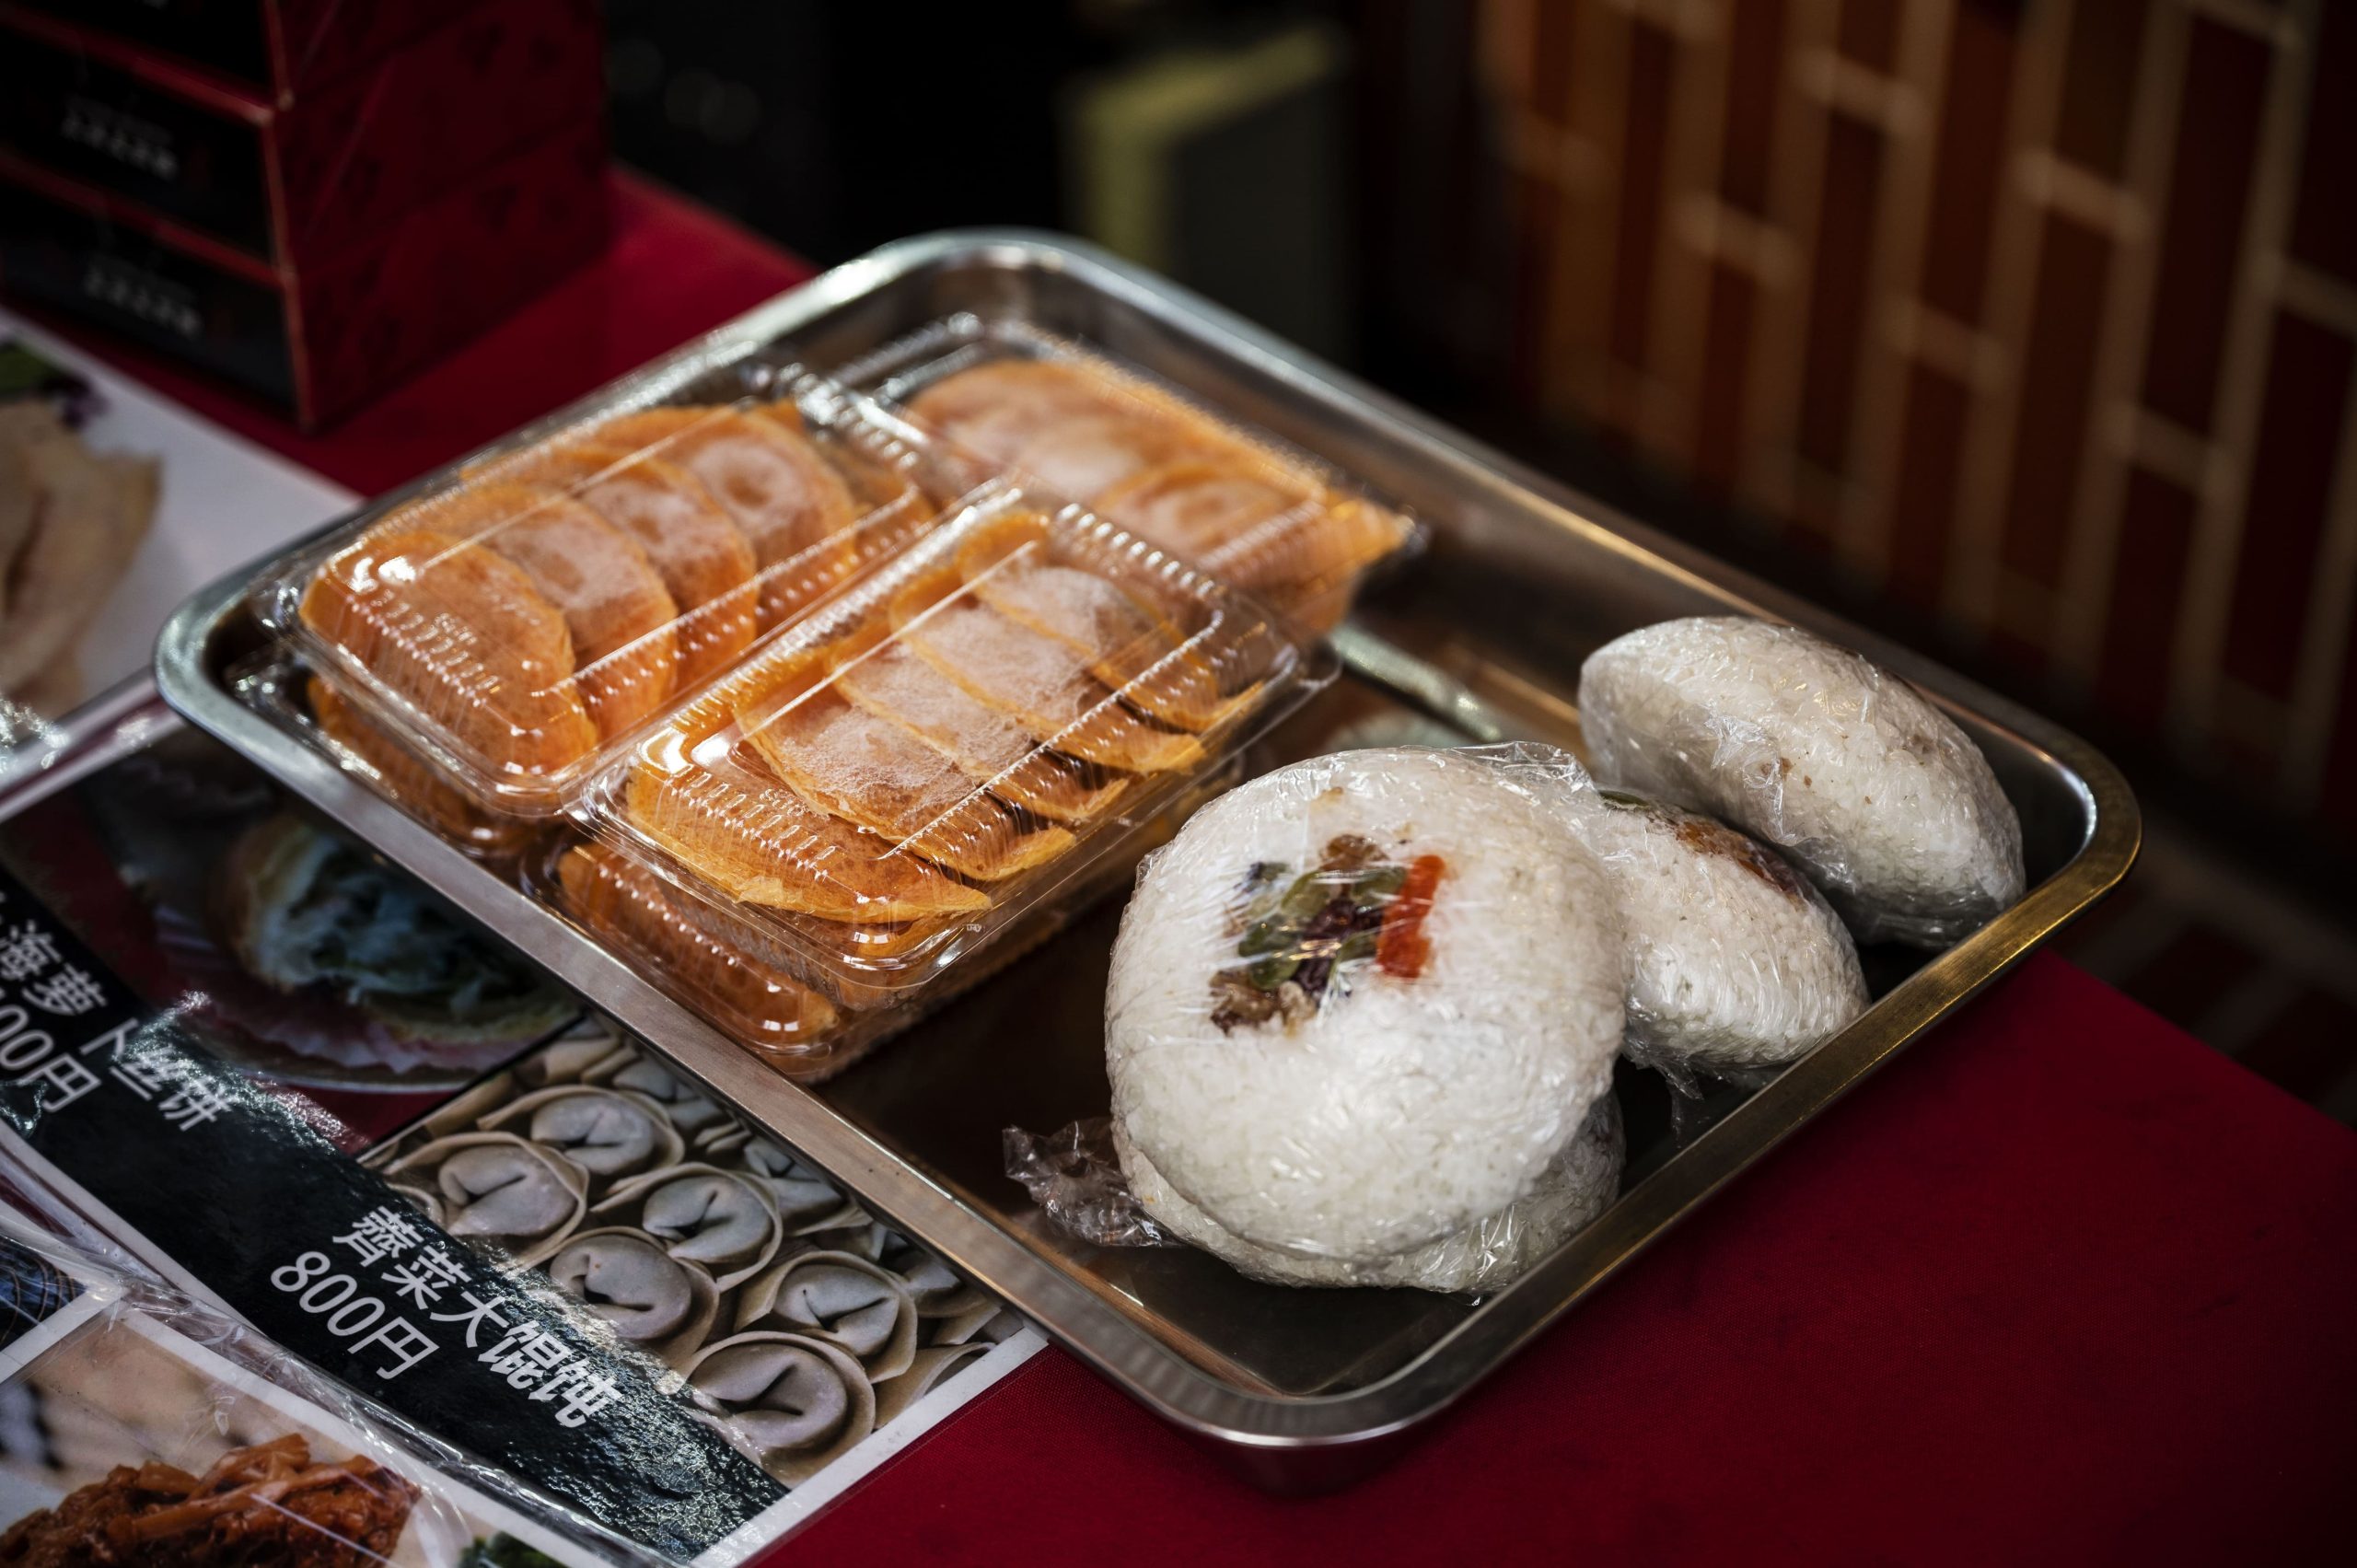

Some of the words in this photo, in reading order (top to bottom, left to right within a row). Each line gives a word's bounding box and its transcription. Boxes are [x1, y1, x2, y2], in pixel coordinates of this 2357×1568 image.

[0, 889, 232, 1132] 海萝卜丝饼
[0, 986, 102, 1113] 00円
[271, 1251, 440, 1380] 800円
